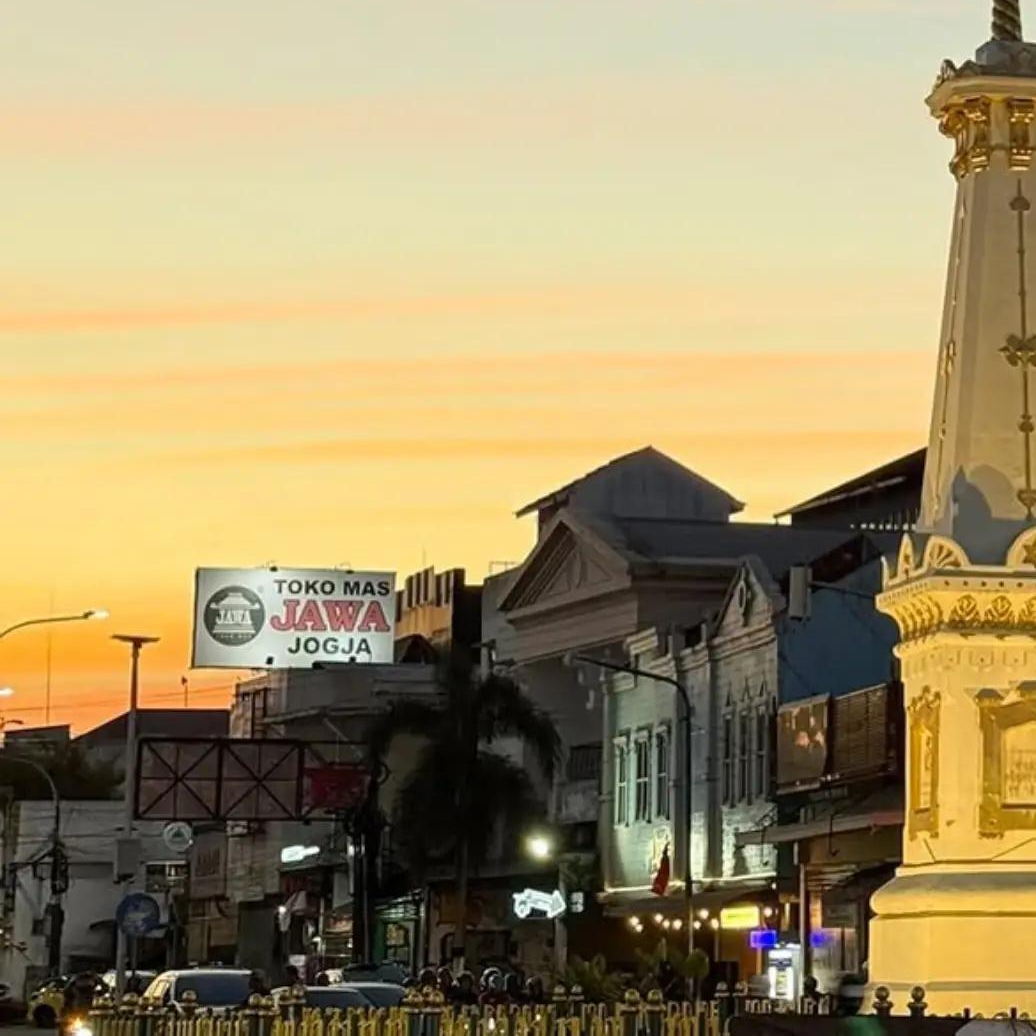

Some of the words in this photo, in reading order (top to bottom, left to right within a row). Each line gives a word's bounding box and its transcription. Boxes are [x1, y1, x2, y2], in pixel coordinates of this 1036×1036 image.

[273, 579, 336, 596] TOKO
[343, 581, 390, 597] MAS
[215, 610, 253, 625] JAWA
[269, 599, 391, 632] JAWA
[287, 637, 372, 655] JOGJA
